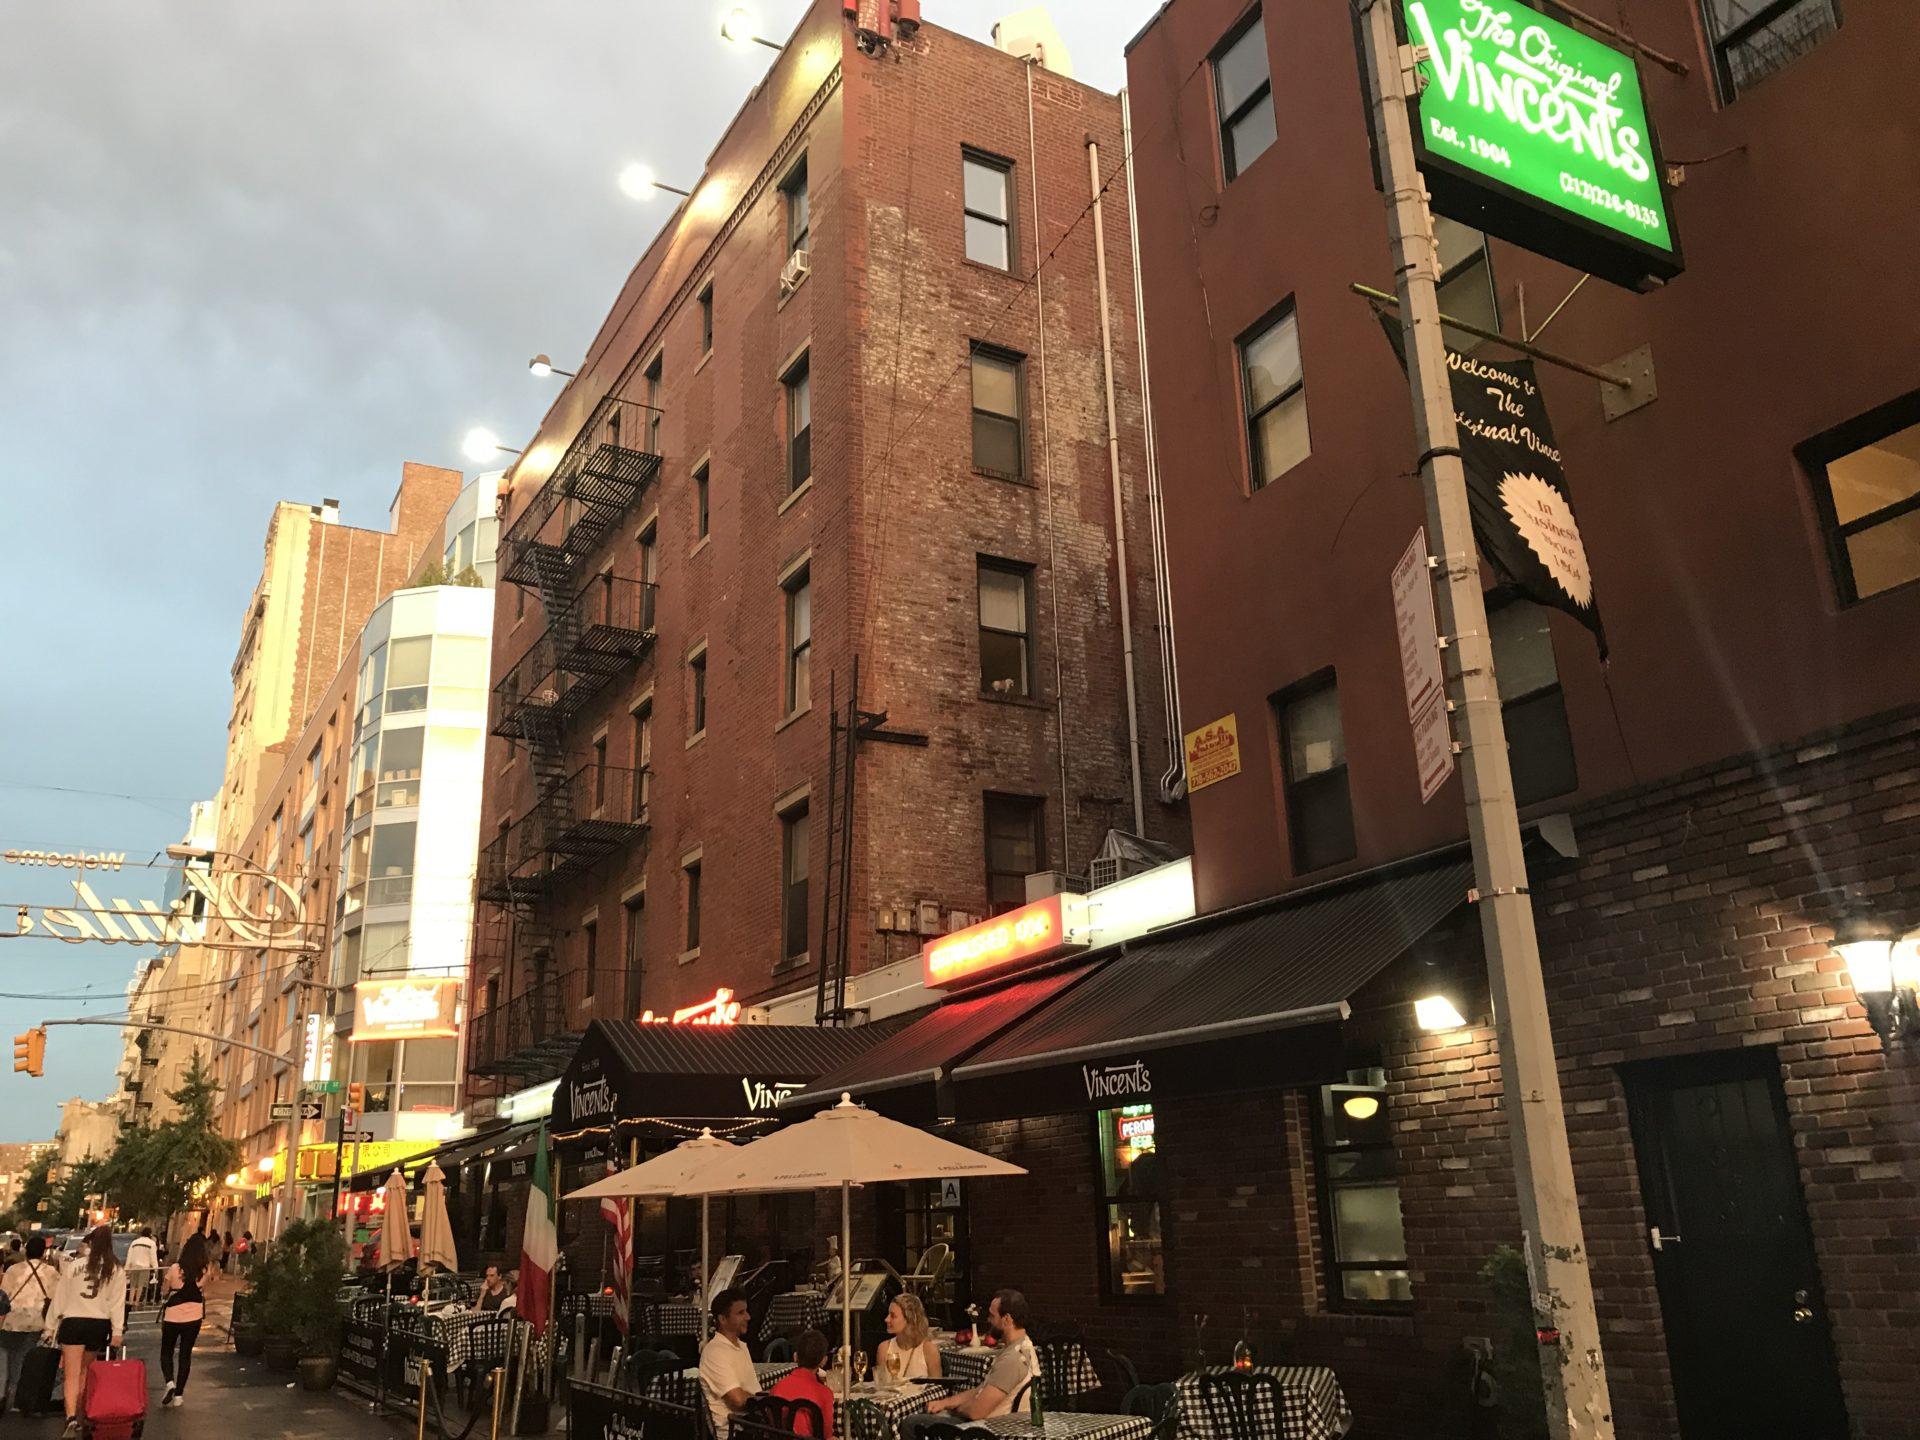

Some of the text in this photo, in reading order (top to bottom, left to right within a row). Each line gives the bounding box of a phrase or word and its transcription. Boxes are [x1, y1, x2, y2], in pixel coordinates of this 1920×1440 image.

[1457, 0, 1622, 101] The Original
[1468, 134, 1512, 168] 1904
[1443, 349, 1520, 389] Welcome
[1486, 387, 1525, 417] The
[1537, 500, 1553, 516] In
[306, 1081, 329, 1093] MOTT
[945, 1182, 958, 1200] A
[80, 1275, 100, 1299] 3
